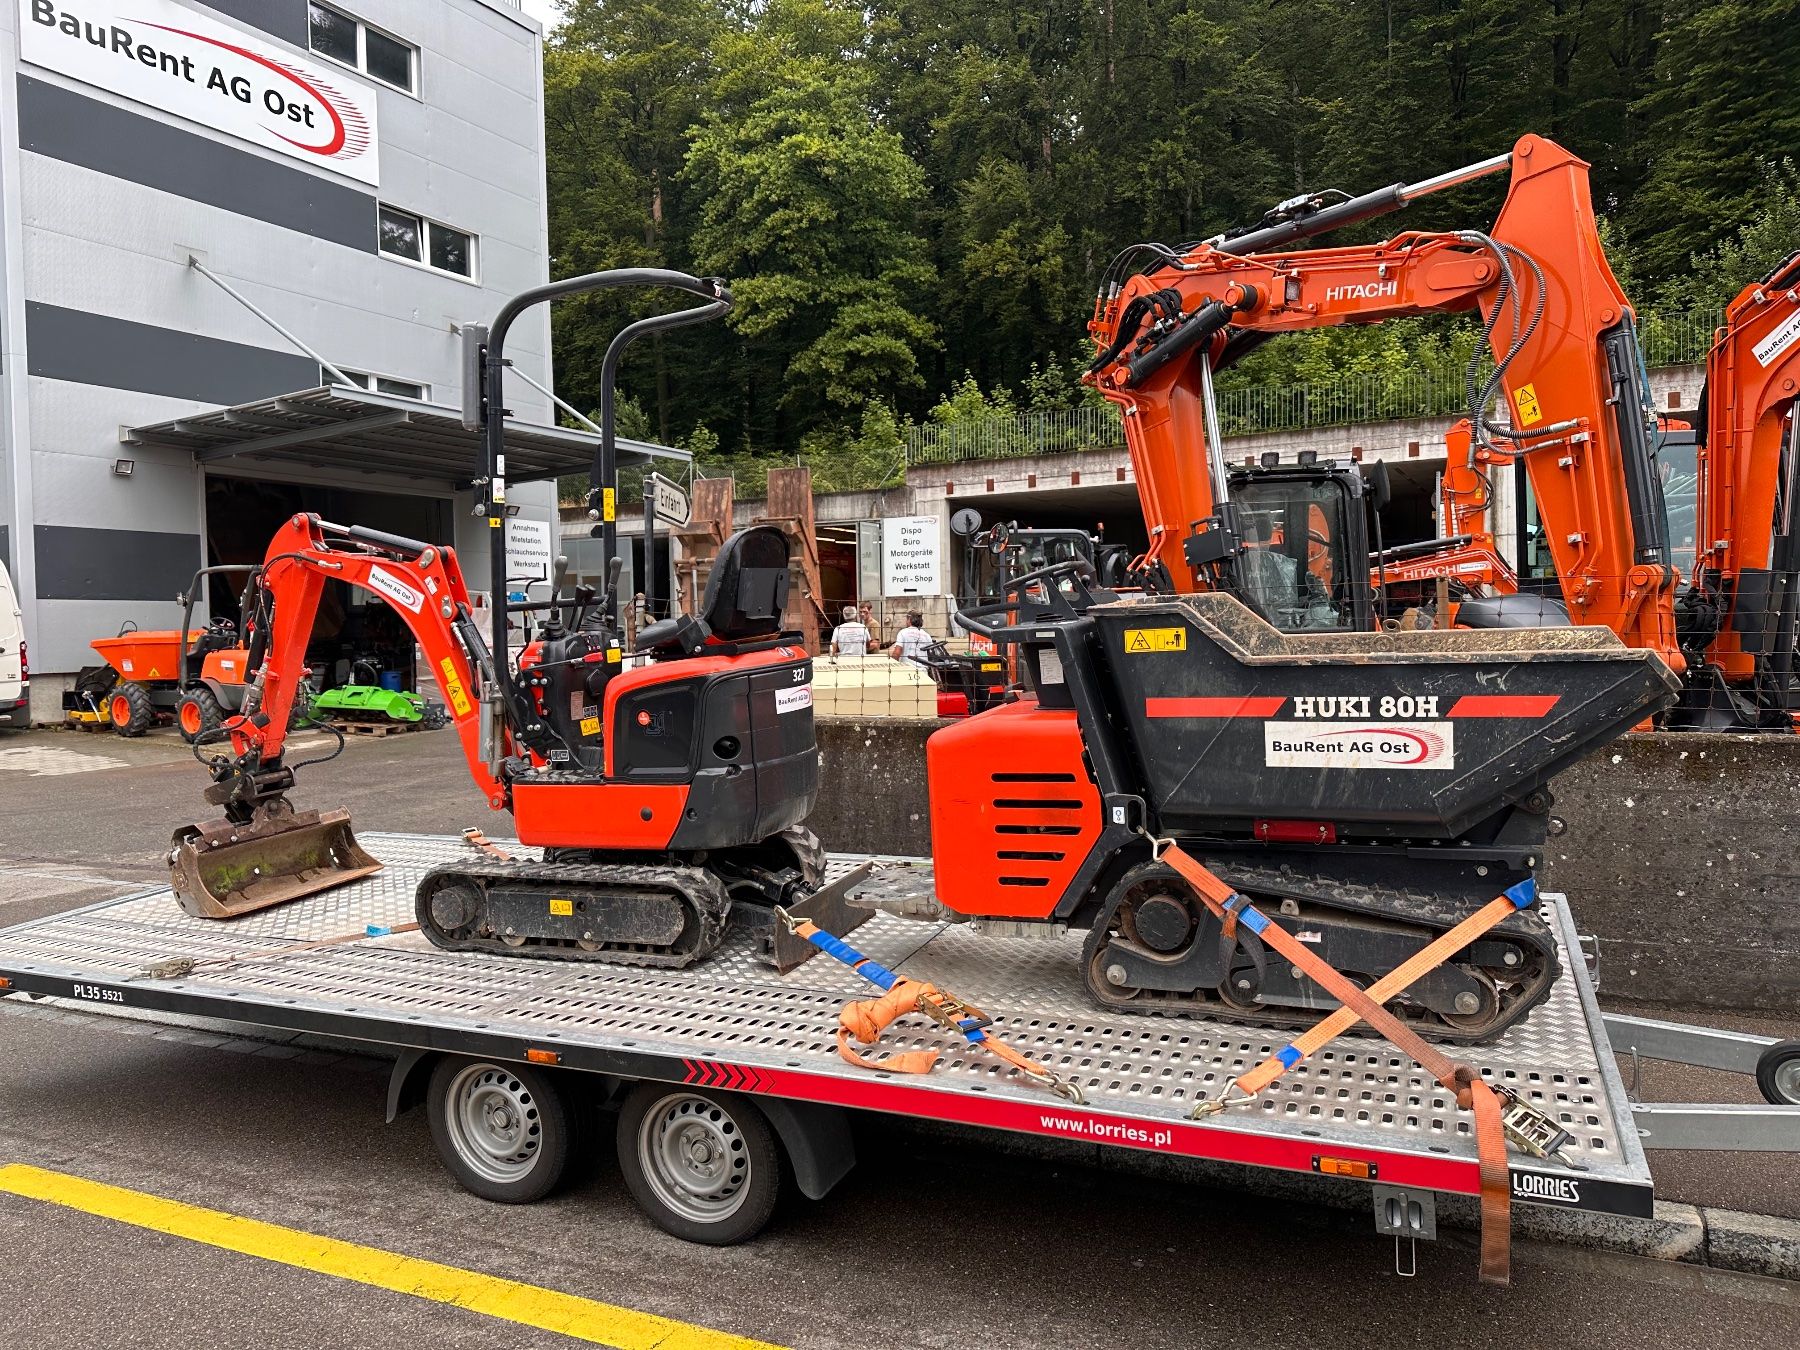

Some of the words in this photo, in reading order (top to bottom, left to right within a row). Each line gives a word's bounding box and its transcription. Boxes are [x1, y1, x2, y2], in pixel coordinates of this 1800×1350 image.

[31, 0, 195, 83] BauRent
[206, 66, 252, 104] AG
[263, 89, 315, 129] Ost
[1326, 281, 1398, 301] HITACHI
[1758, 330, 1792, 361] BauRent
[512, 523, 539, 532] Annahme
[901, 527, 922, 536] Dispo
[510, 535, 542, 544] Mietstation
[902, 538, 921, 546] Büro
[890, 549, 933, 558] Motorgeräte
[513, 560, 541, 568] Werkstatt
[894, 562, 930, 570] Werkstatt
[1403, 565, 1460, 579] HITACHI
[892, 575, 909, 583] Profi
[914, 575, 933, 583] Shop
[372, 573, 393, 589] BauRent
[393, 586, 401, 595] AG
[401, 592, 411, 601] Ost
[793, 668, 805, 681] 327
[1293, 696, 1371, 718] HUKI
[1379, 695, 1439, 718] 80H
[1272, 741, 1344, 753] BauRent
[1349, 741, 1374, 753] AG
[1379, 742, 1410, 753] Ost
[74, 985, 100, 999] PL35
[102, 990, 123, 1001] 5521
[1039, 1115, 1172, 1147] www.lorries.pl
[1513, 1173, 1580, 1203] LORRIES
